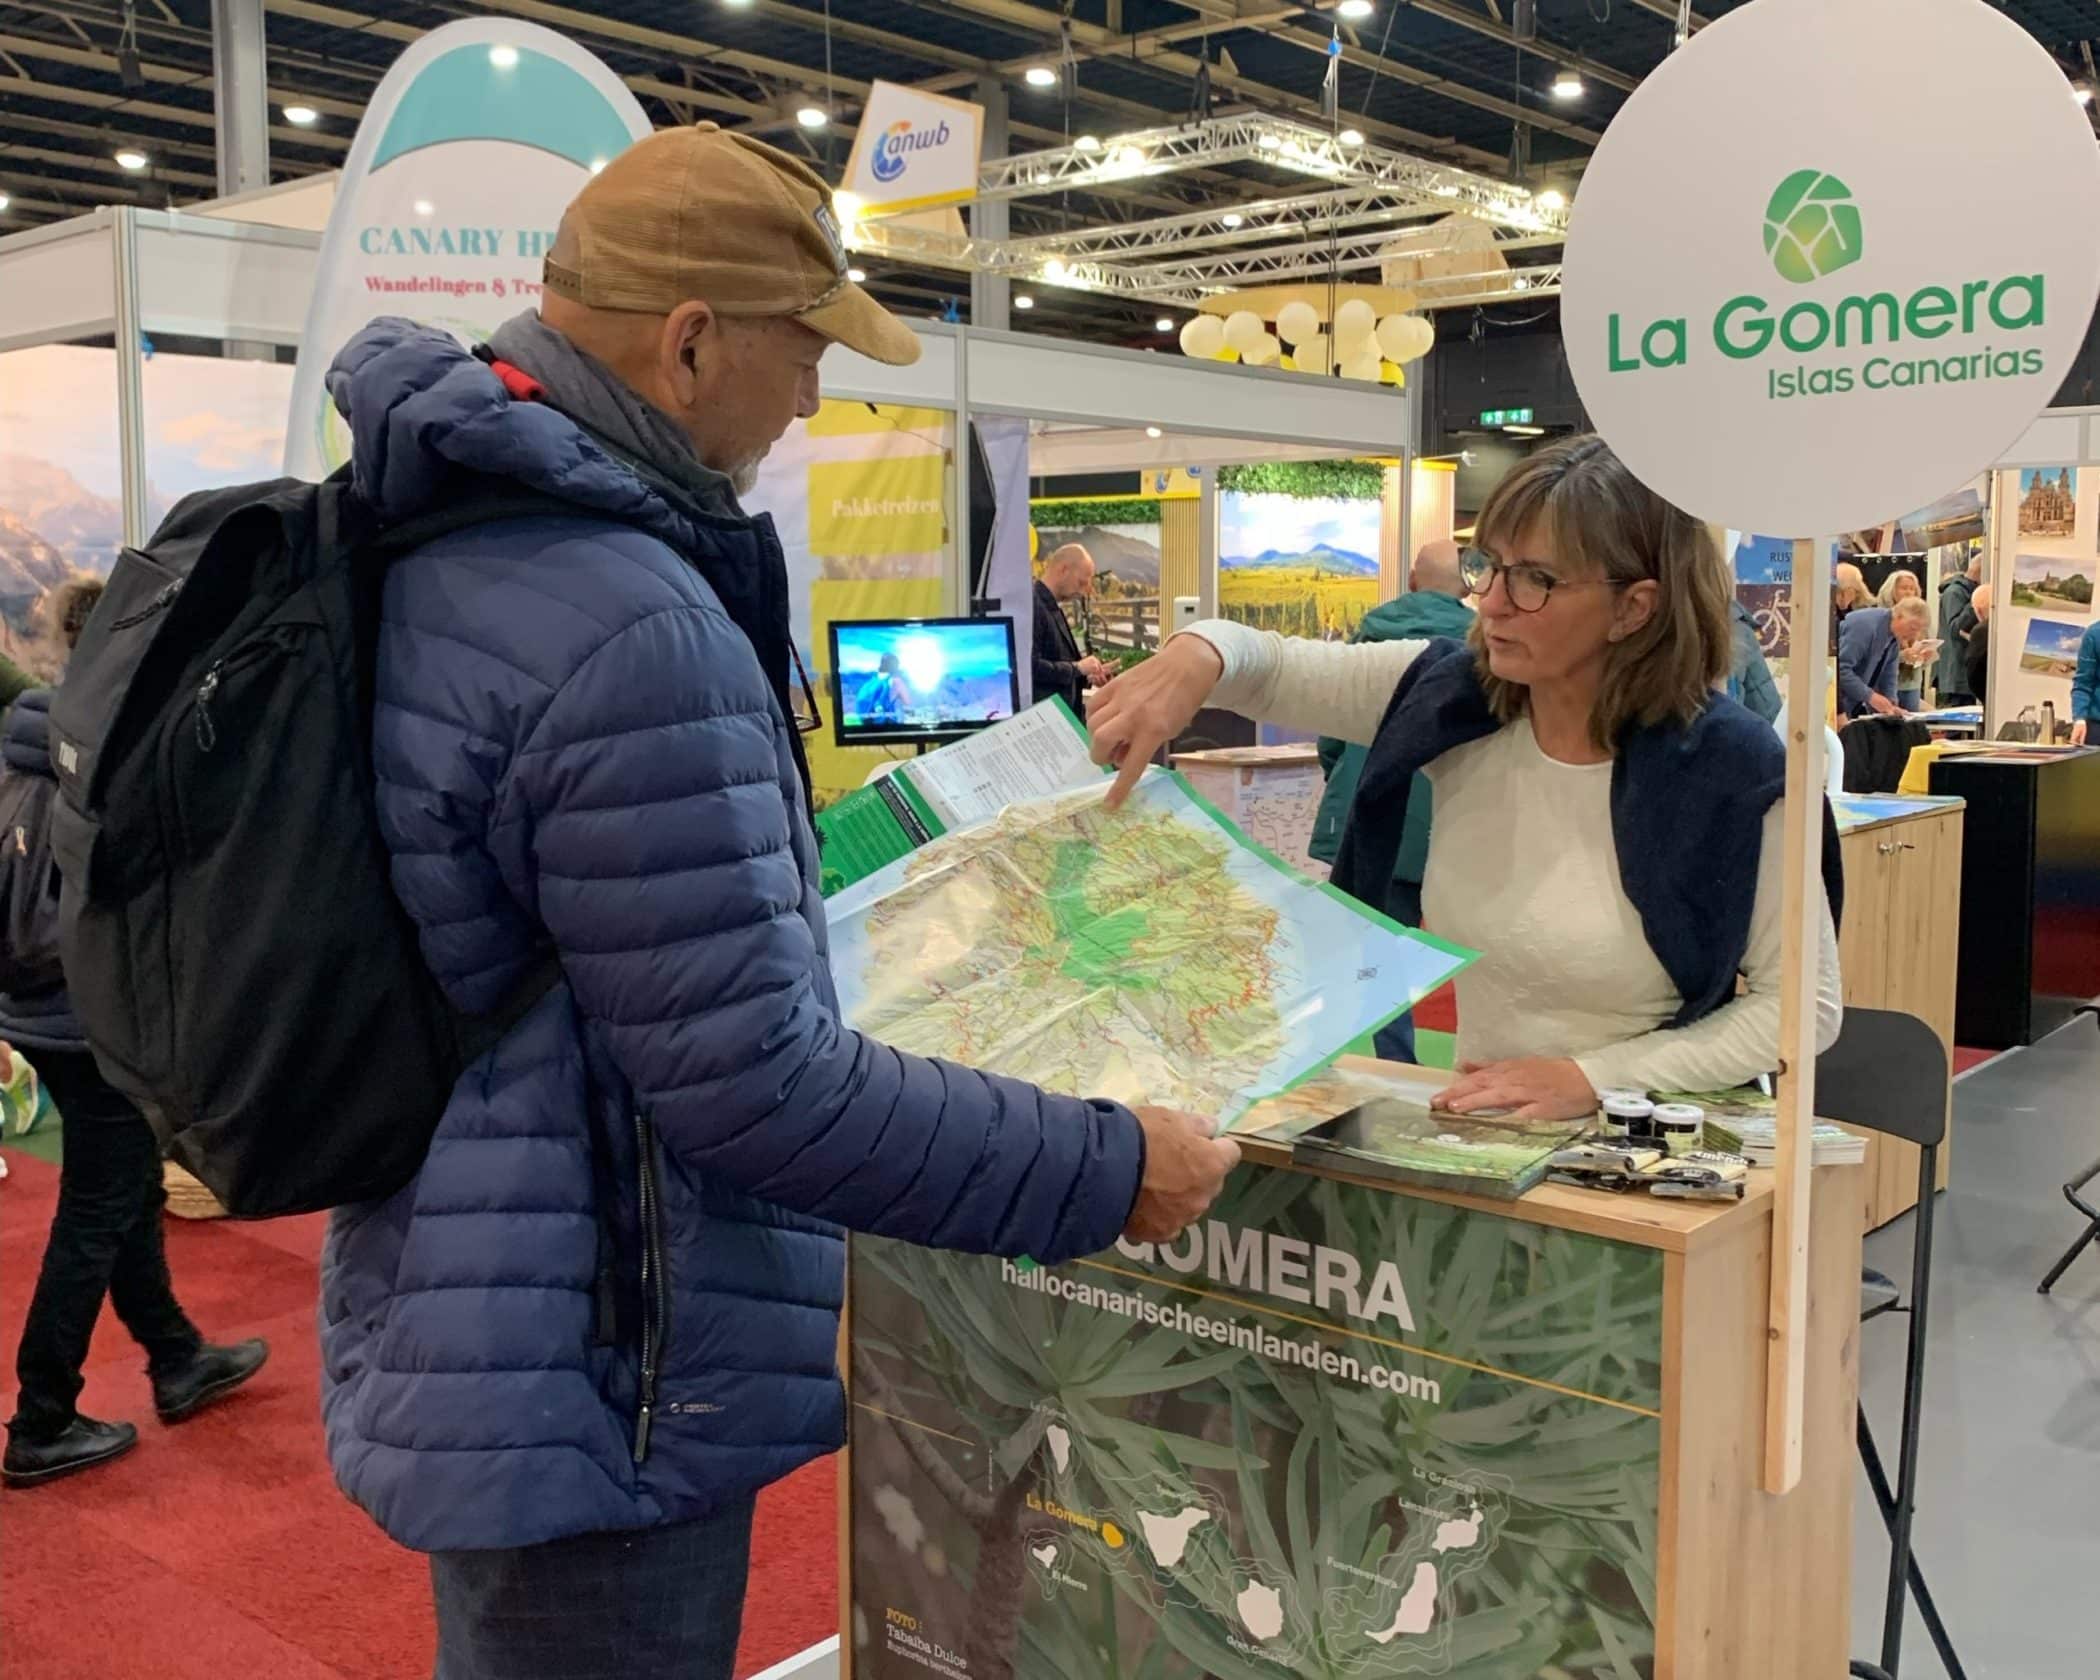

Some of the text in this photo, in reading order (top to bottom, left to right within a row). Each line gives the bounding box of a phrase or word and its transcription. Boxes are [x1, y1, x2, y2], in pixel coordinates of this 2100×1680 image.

[887, 120, 950, 154] anwb
[359, 227, 502, 256] CANARY
[365, 275, 487, 297] Wandelingen
[1608, 274, 2046, 372] La Gomera
[1768, 346, 2044, 399] Islas Canarias
[1770, 551, 1792, 562] RUS
[1026, 1493, 1098, 1532] La Gomera
[886, 1623, 968, 1669] Tabaiba Dulce
